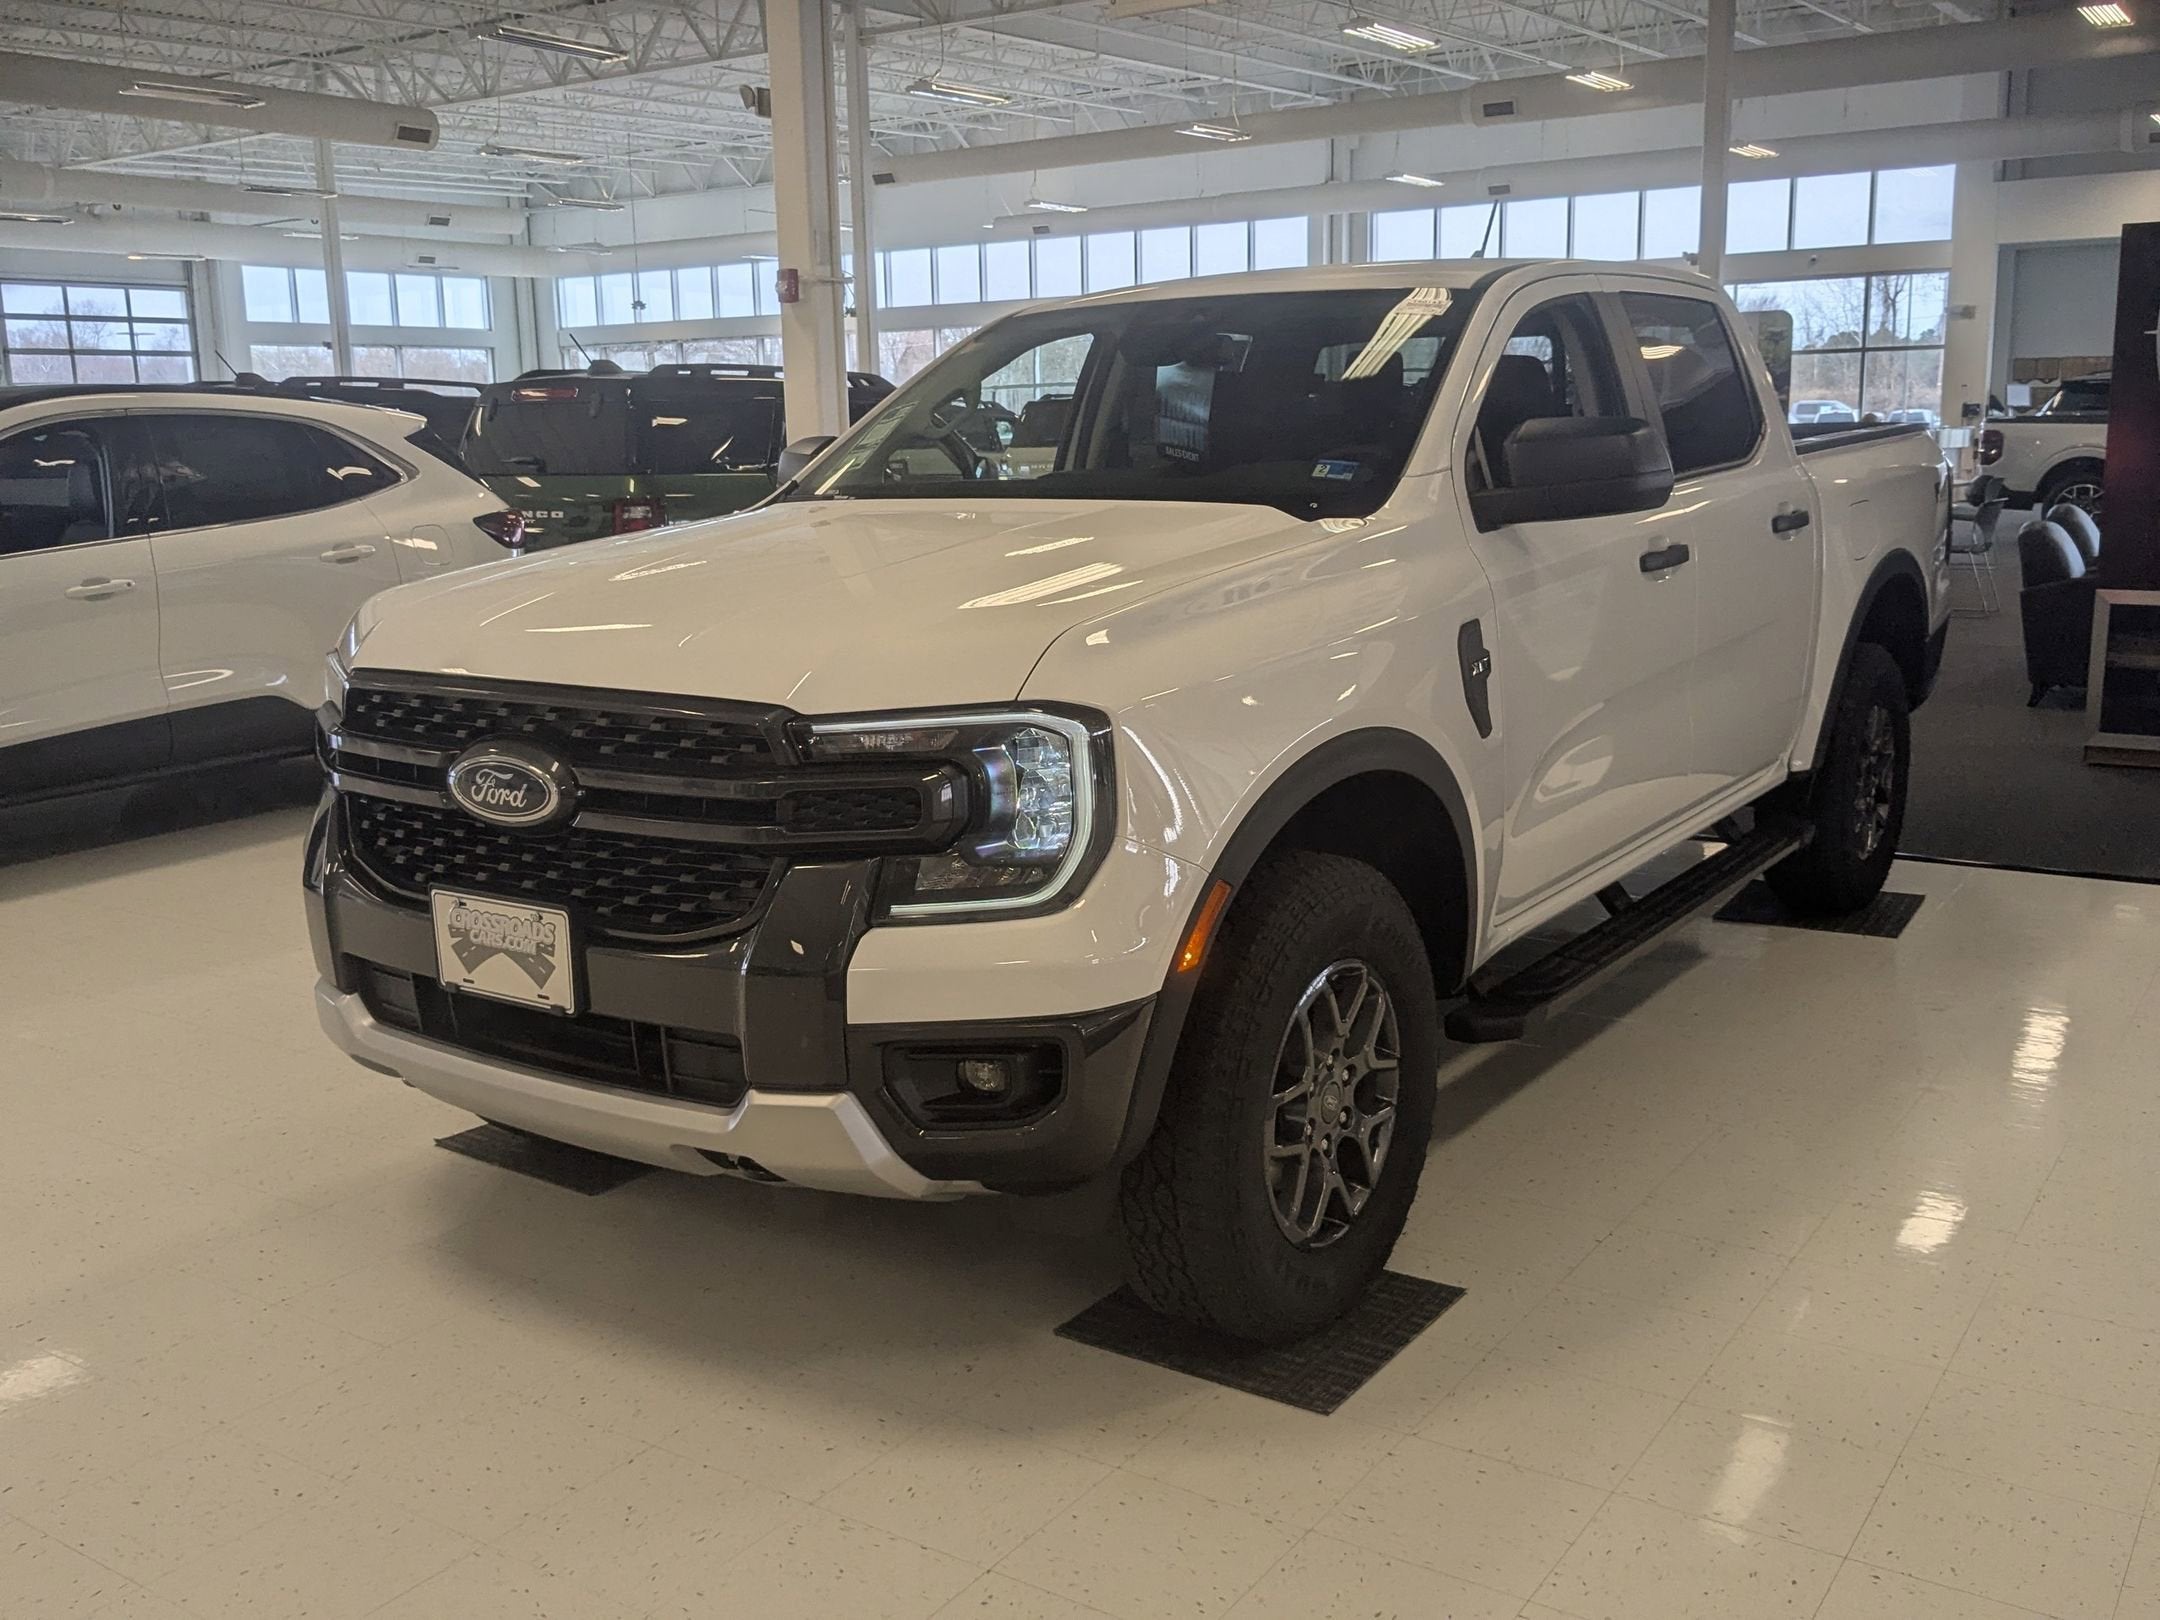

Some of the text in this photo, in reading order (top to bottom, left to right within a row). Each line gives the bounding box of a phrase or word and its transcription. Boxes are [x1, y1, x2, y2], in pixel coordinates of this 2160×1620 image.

[1319, 464, 1328, 474] 2
[521, 510, 564, 519] NCO
[471, 768, 528, 808] Ford
[450, 907, 556, 946] CROSSROADS
